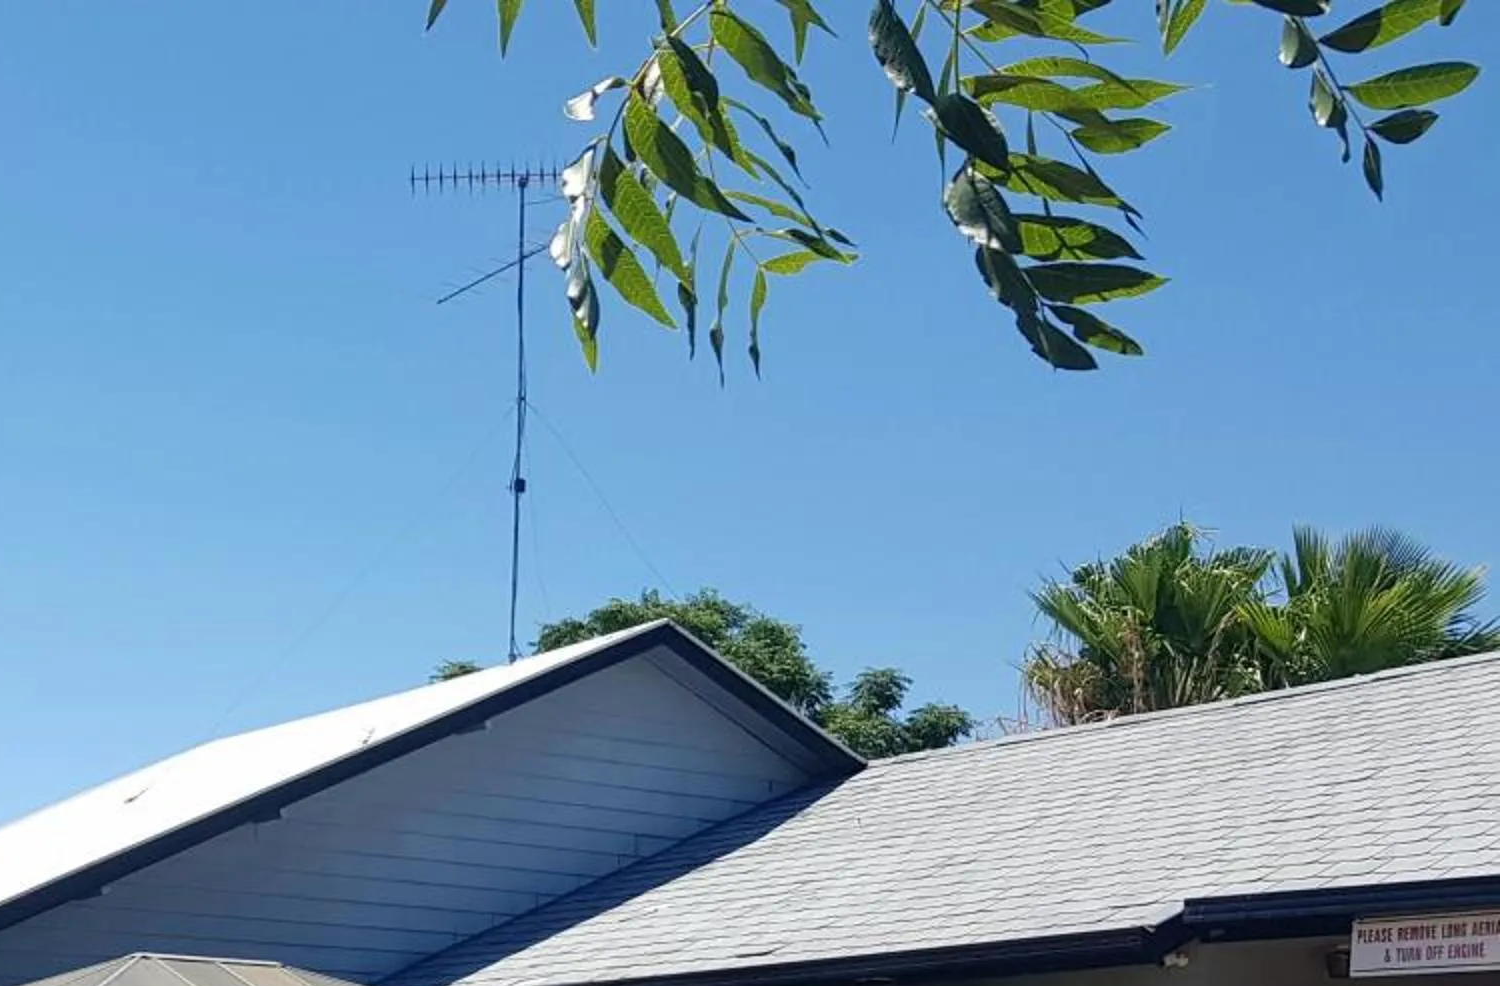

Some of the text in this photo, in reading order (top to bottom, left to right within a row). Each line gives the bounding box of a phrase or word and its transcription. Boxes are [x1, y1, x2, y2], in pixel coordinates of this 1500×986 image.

[1357, 927, 1393, 944] PLEASE
[1397, 924, 1437, 941] REMOVE
[1441, 922, 1468, 939] LONG
[1384, 942, 1485, 963] & TURN OFF ENGINE
